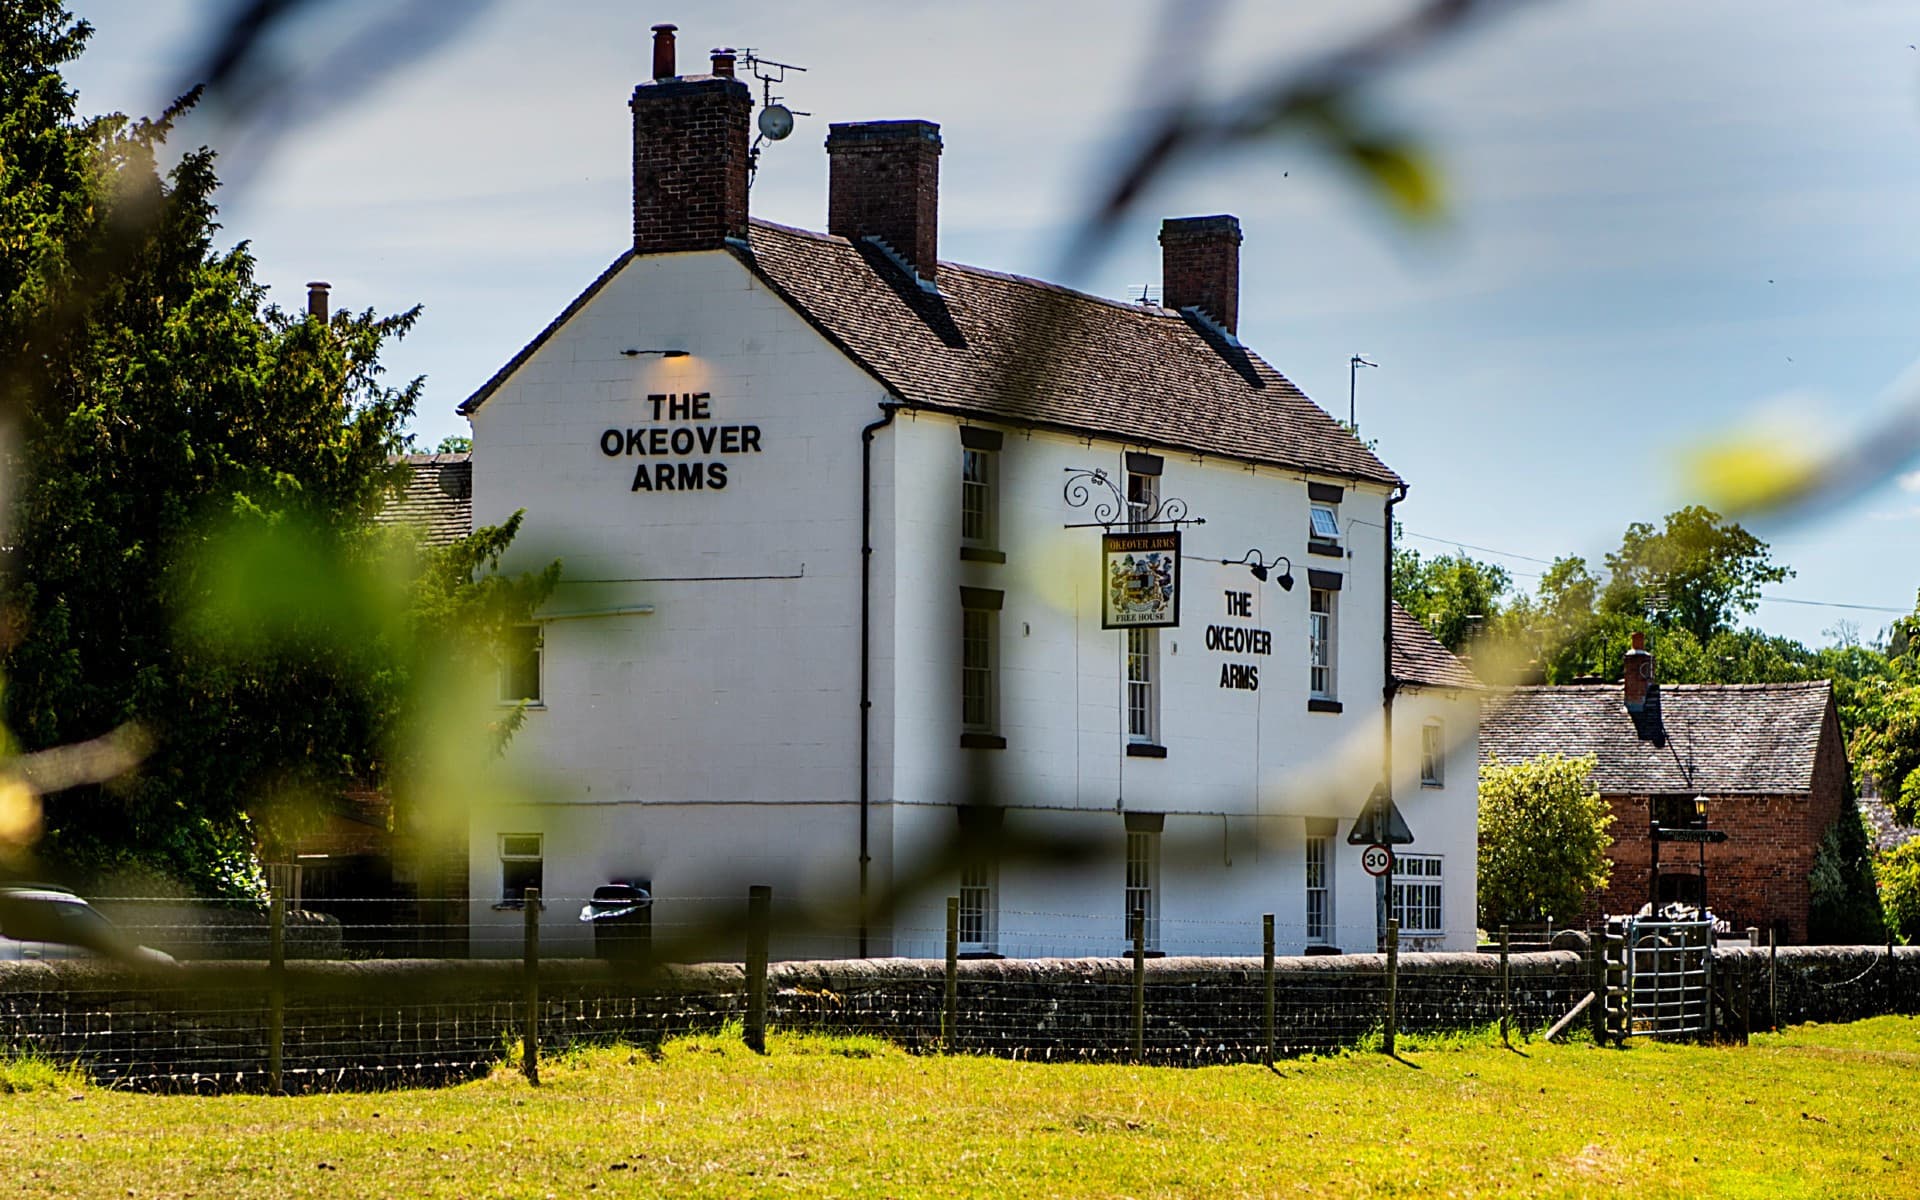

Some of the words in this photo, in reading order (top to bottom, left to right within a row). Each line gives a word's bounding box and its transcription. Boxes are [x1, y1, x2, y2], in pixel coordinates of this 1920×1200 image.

[647, 392, 711, 421] THE
[600, 425, 762, 457] OKEOVER
[631, 462, 728, 491] ARMS
[1109, 538, 1149, 550] OKEOVER
[1151, 537, 1175, 549] ARMS
[1116, 614, 1137, 622] FREE
[1138, 612, 1165, 622] HOUSE
[1224, 590, 1252, 617] THE
[1205, 624, 1271, 655] OKEOVER
[1220, 663, 1258, 691] ARMS
[1366, 853, 1388, 867] 30
